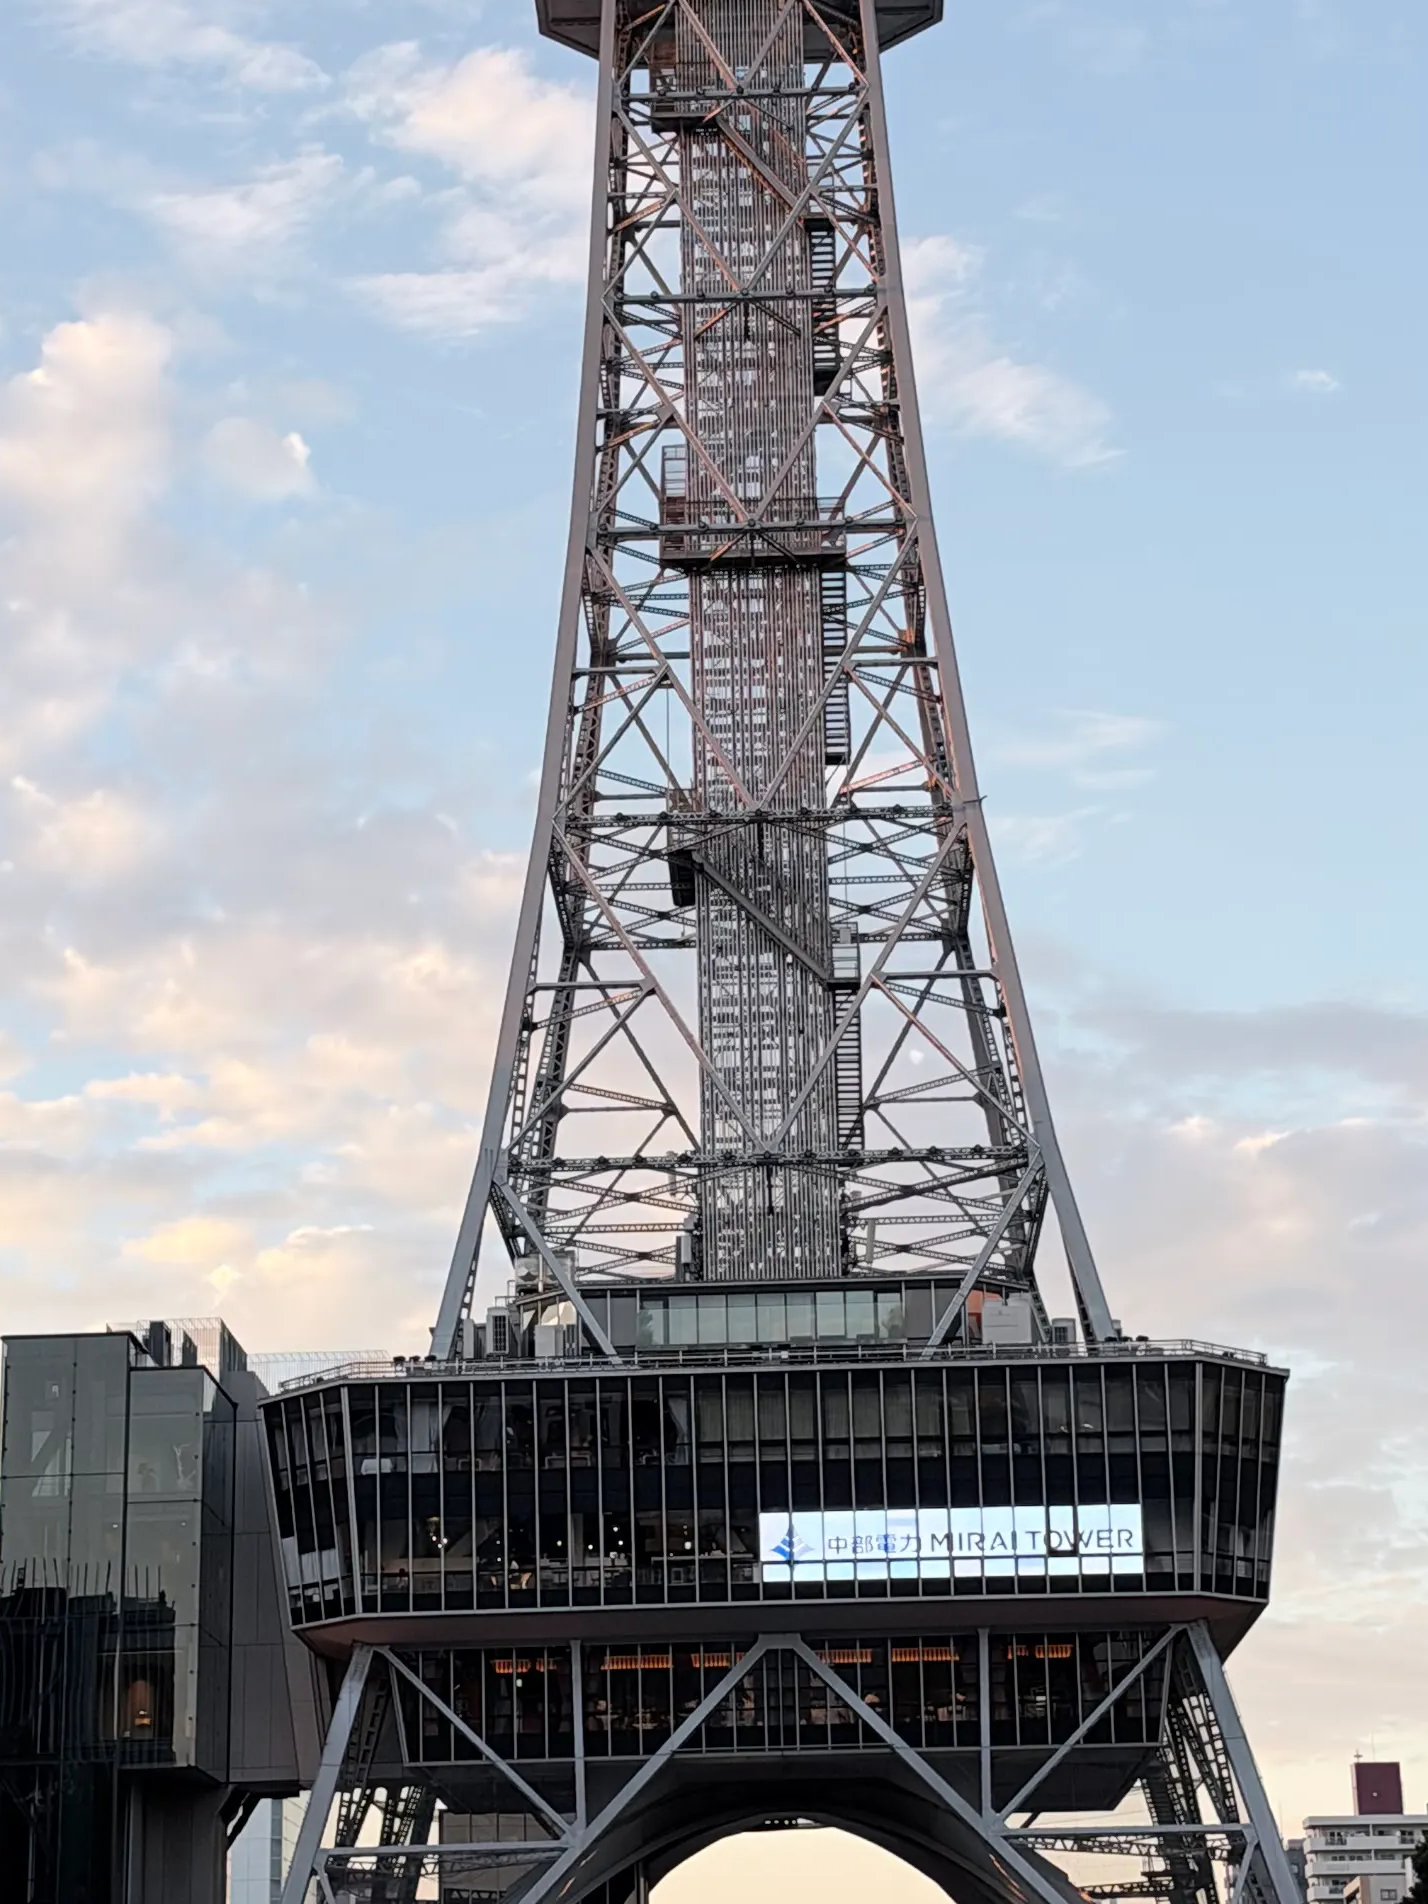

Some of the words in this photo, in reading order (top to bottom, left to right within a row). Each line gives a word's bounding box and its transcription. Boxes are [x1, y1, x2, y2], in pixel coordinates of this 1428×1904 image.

[827, 1534, 922, 1555] 中部電力
[930, 1529, 1017, 1553] MIRAI
[1025, 1527, 1134, 1552] TOWER
